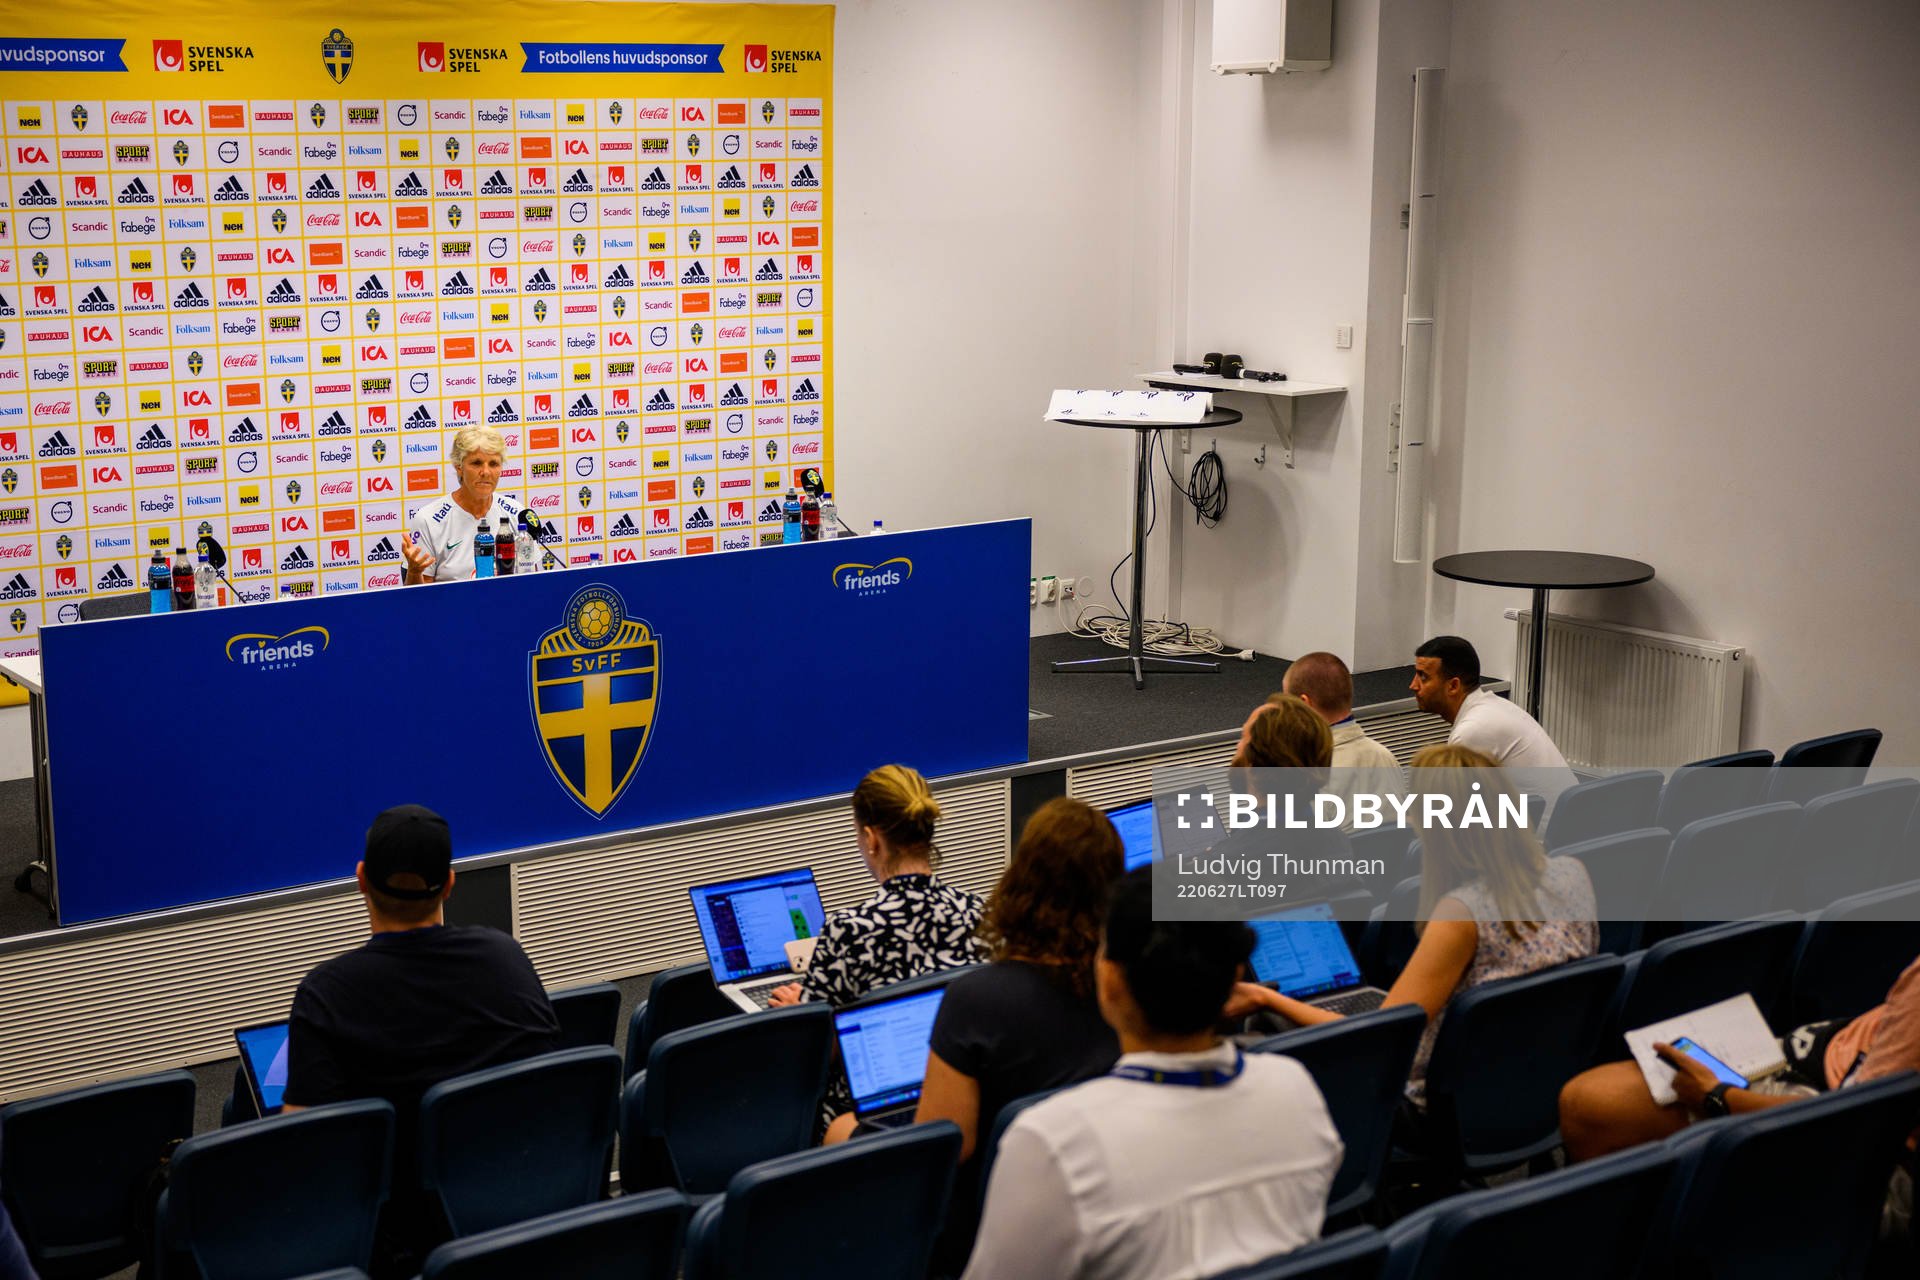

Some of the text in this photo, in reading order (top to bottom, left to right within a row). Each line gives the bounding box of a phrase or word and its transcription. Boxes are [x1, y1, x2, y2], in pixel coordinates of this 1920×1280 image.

[0, 46, 104, 65] vudsponsor
[188, 47, 254, 59] SVENSKA
[449, 49, 508, 60] SVENSKA
[772, 51, 821, 61] SVENSKA
[539, 50, 708, 68] Fotbollens huvudsponsor
[189, 61, 224, 72] SPEL
[449, 62, 480, 73] SPEL
[772, 63, 798, 73] SPEL
[164, 109, 193, 125] ICA
[255, 112, 293, 120] BAUHAUS
[434, 111, 466, 119] Scandic
[478, 110, 508, 123] Fabege
[520, 110, 550, 119] Folksam
[682, 107, 704, 121] ICA
[565, 140, 589, 154] ICA
[756, 140, 782, 148] Scandic
[62, 150, 103, 159] BAUHAUS
[258, 147, 292, 156] Scandic
[304, 147, 336, 160] Fabege
[349, 146, 381, 155] Folksam
[563, 184, 593, 192] adidas
[717, 180, 746, 188] adidas
[214, 191, 249, 201] adidas
[395, 187, 428, 196] adidas
[19, 196, 57, 206] adidas
[604, 208, 632, 216] Scandic
[642, 206, 670, 218] Fabege
[681, 205, 709, 213] Folksam
[355, 212, 382, 226] ICA
[480, 211, 514, 219] BAUHAUS
[121, 221, 155, 235] Fabege
[604, 240, 633, 248] Folksam
[218, 253, 254, 262] BAUHAUS
[267, 248, 294, 264] ICA
[354, 248, 386, 258] Scandic
[75, 258, 111, 268] Folksam
[604, 278, 634, 288] adidas
[442, 285, 474, 295] adidas
[266, 293, 300, 303] adidas
[720, 296, 746, 309] Fabege
[78, 302, 115, 312] adidas
[443, 312, 474, 320] Folksam
[129, 327, 163, 336] Scandic
[223, 321, 256, 335] Fabege
[756, 326, 783, 335] Folksam
[28, 332, 69, 341] BAUHAUS
[83, 326, 113, 342] ICA
[609, 332, 632, 346] ICA
[489, 339, 513, 354] ICA
[527, 339, 556, 348] Scandic
[362, 346, 388, 361] ICA
[791, 354, 820, 362] BAUHAUS
[270, 355, 304, 364] Folksam
[129, 362, 168, 371] BAUHAUS
[686, 358, 708, 372] ICA
[34, 367, 69, 382] Fabege
[488, 373, 516, 386] Fabege
[446, 377, 476, 386] Scandic
[315, 384, 351, 394] BAUHAUS
[720, 397, 748, 406] adidas
[568, 407, 598, 417] adidas
[404, 420, 436, 429] adidas
[758, 416, 784, 425] Scandic
[645, 425, 676, 434] BAUHAUS
[228, 433, 263, 442] adidas
[572, 428, 596, 443] ICA
[39, 447, 76, 457] adidas
[406, 444, 437, 453] Folksam
[276, 453, 308, 463] Scandic
[320, 451, 351, 462] Fabege
[685, 454, 712, 462] Folksam
[722, 448, 749, 461] Fabege
[93, 467, 122, 483] ICA
[720, 480, 751, 488] BAUHAUS
[610, 490, 638, 499] Folksam
[140, 500, 174, 512] Fabege
[187, 496, 221, 506] Folksam
[93, 503, 128, 514] Scandic
[498, 498, 518, 515] Itaú
[366, 512, 397, 522] Scandic
[432, 502, 452, 523] Itaú
[282, 516, 308, 532] ICA
[686, 520, 714, 529] adidas
[368, 551, 400, 561] adidas
[614, 548, 636, 563] ICA
[650, 547, 677, 556] Scandic
[323, 560, 346, 568] SVENSKA
[97, 579, 133, 590] adidas
[844, 570, 900, 590] friends
[326, 582, 358, 591] Folksam
[0, 588, 36, 600] adidas
[241, 640, 314, 664] friends
[261, 662, 296, 671] ARENA
[572, 653, 621, 672] SvFF
